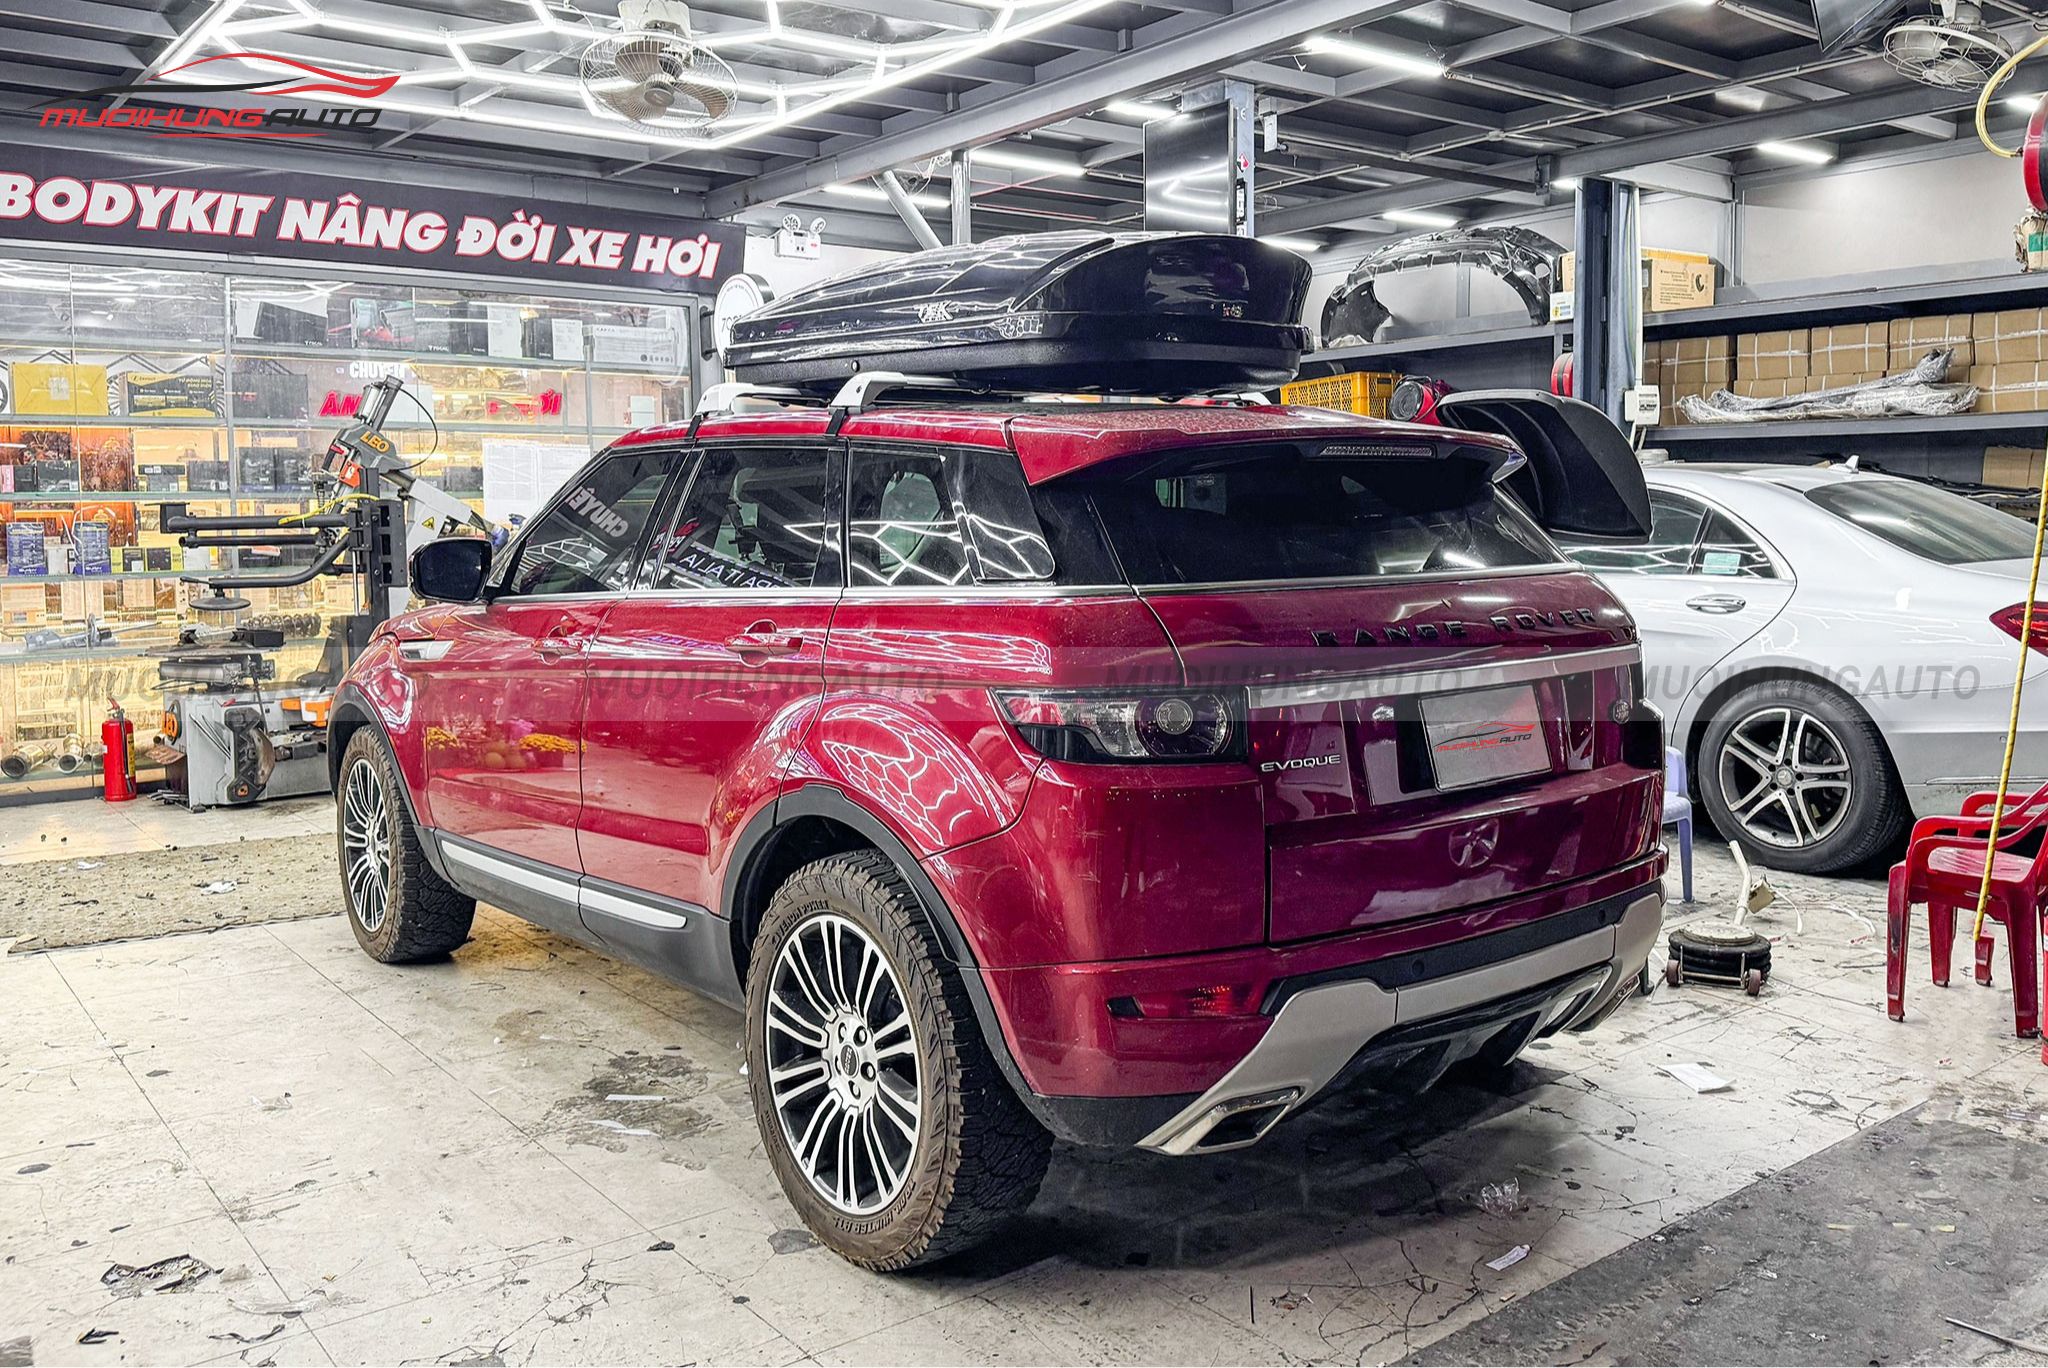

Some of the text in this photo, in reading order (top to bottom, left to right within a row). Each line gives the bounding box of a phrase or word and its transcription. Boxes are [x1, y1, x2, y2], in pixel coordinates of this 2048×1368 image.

[0, 170, 722, 279] BODYKIT NÂNG ĐỜI XE HƠI
[360, 431, 390, 453] LEO
[1311, 607, 1597, 647] RANGE ROVER
[1260, 754, 1341, 772] EVOQUE
